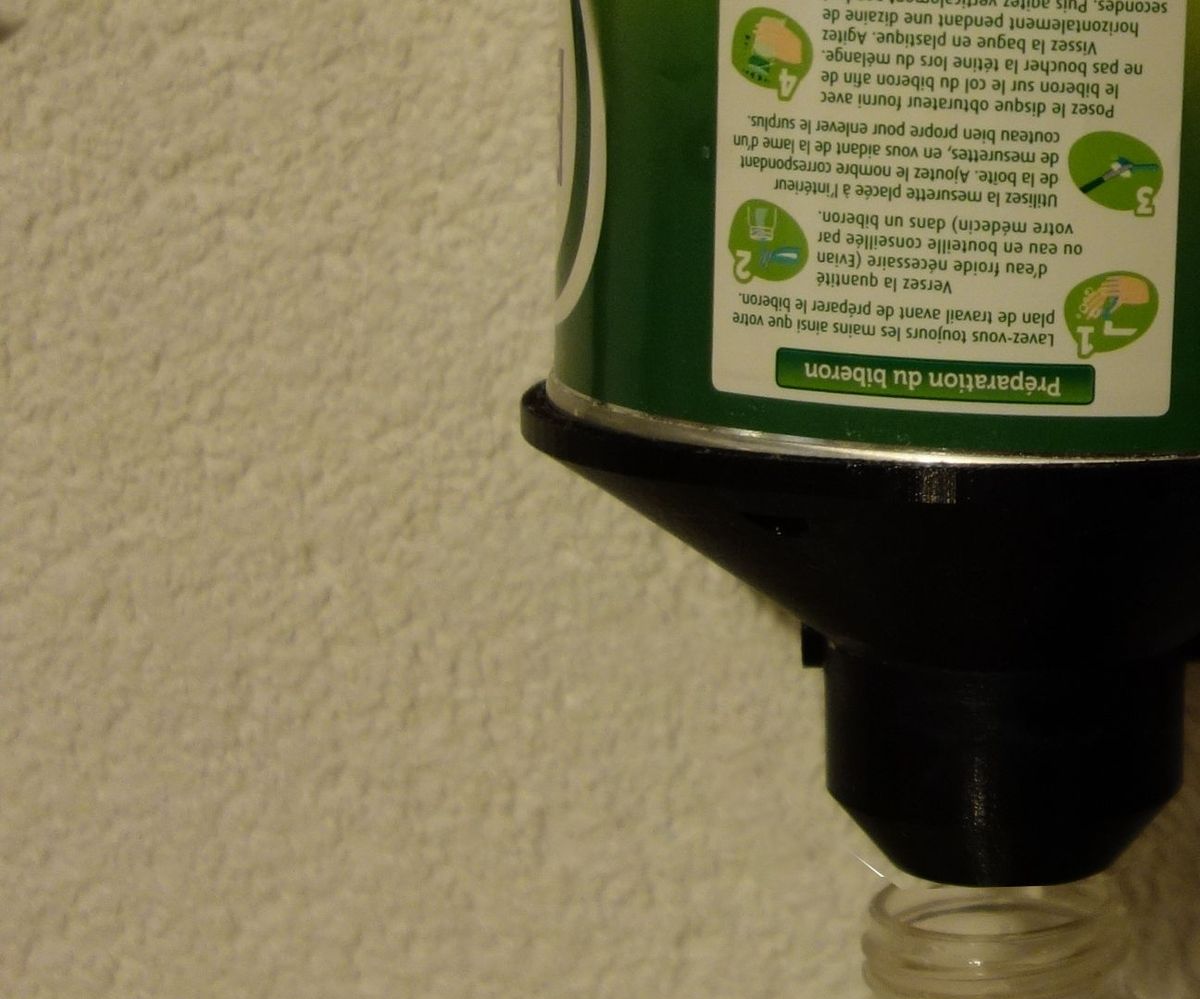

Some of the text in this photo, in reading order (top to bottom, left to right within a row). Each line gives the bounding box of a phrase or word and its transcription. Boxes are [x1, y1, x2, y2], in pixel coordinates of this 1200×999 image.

[1055, 0, 1088, 14] Puis
[1093, 0, 1168, 17] secondes.
[822, 8, 1139, 38] horizontalement pendant une dizaine de
[822, 26, 1097, 56] Vissez la bague en plastique. Agitez
[821, 46, 1143, 78] ne pas boucher la tétine lors du mélange.
[779, 68, 799, 98] 4
[820, 70, 1119, 100] le biberon sur le col du biberon afin de
[820, 91, 1115, 119] Posez le disque obturateur fourni avec
[747, 113, 1061, 145] couteau bien propre pour enlever le surplus.
[733, 134, 1060, 169] de mesurettes, en vous aidant de la lame d'un
[740, 155, 1059, 189] de la boîte. Ajoutez le nombre correspondant
[773, 178, 1058, 209] Utilisez la mesurette placée à l'intérieur
[1135, 185, 1154, 215] 3
[818, 211, 1074, 237] votre médecin) dans un biberon.
[817, 228, 1083, 257] ou eau en bouteille conseillée par
[735, 249, 753, 280] 2
[816, 250, 1048, 279] d'eau froide nécessaire (Evian
[816, 271, 953, 295] Versez la quantité
[738, 293, 1055, 329] plan de travail avant de préparer le biberon.
[732, 311, 1055, 347] Lavez-vous toujours les mains ainsi que votre
[1075, 326, 1095, 356] 1
[802, 361, 1063, 399] Préparation du biberon
